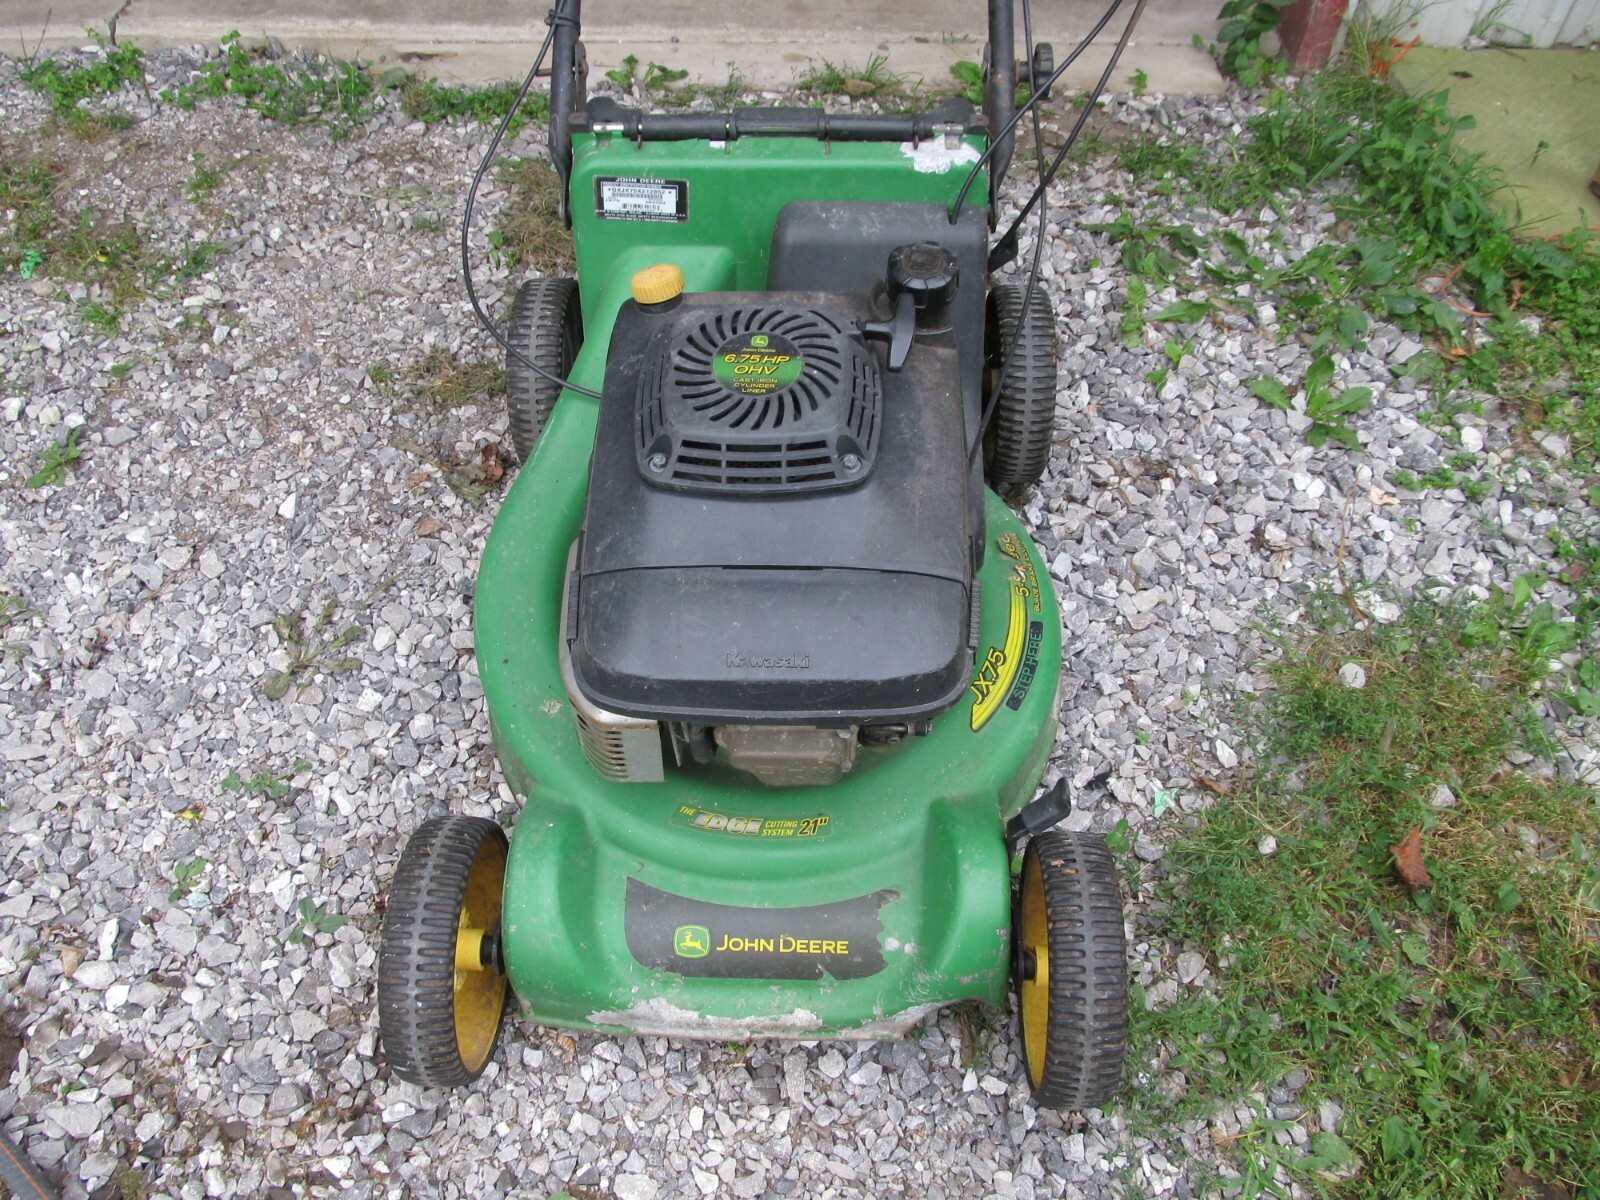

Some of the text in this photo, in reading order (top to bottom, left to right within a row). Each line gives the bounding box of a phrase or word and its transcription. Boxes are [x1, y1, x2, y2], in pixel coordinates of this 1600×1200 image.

[724, 354, 790, 365] 6.75 HP
[734, 365, 778, 375] OHV
[1025, 561, 1038, 587] BRAKE
[1033, 588, 1041, 613] BLADE
[970, 647, 1007, 706] JX75
[1013, 632, 1042, 700] STEP HERE
[679, 806, 763, 835] THE EDGE
[765, 820, 797, 828] CUTTING
[798, 817, 829, 836] 21"
[762, 828, 793, 836] SYSTEM
[716, 934, 849, 955] JOHN DEERE
